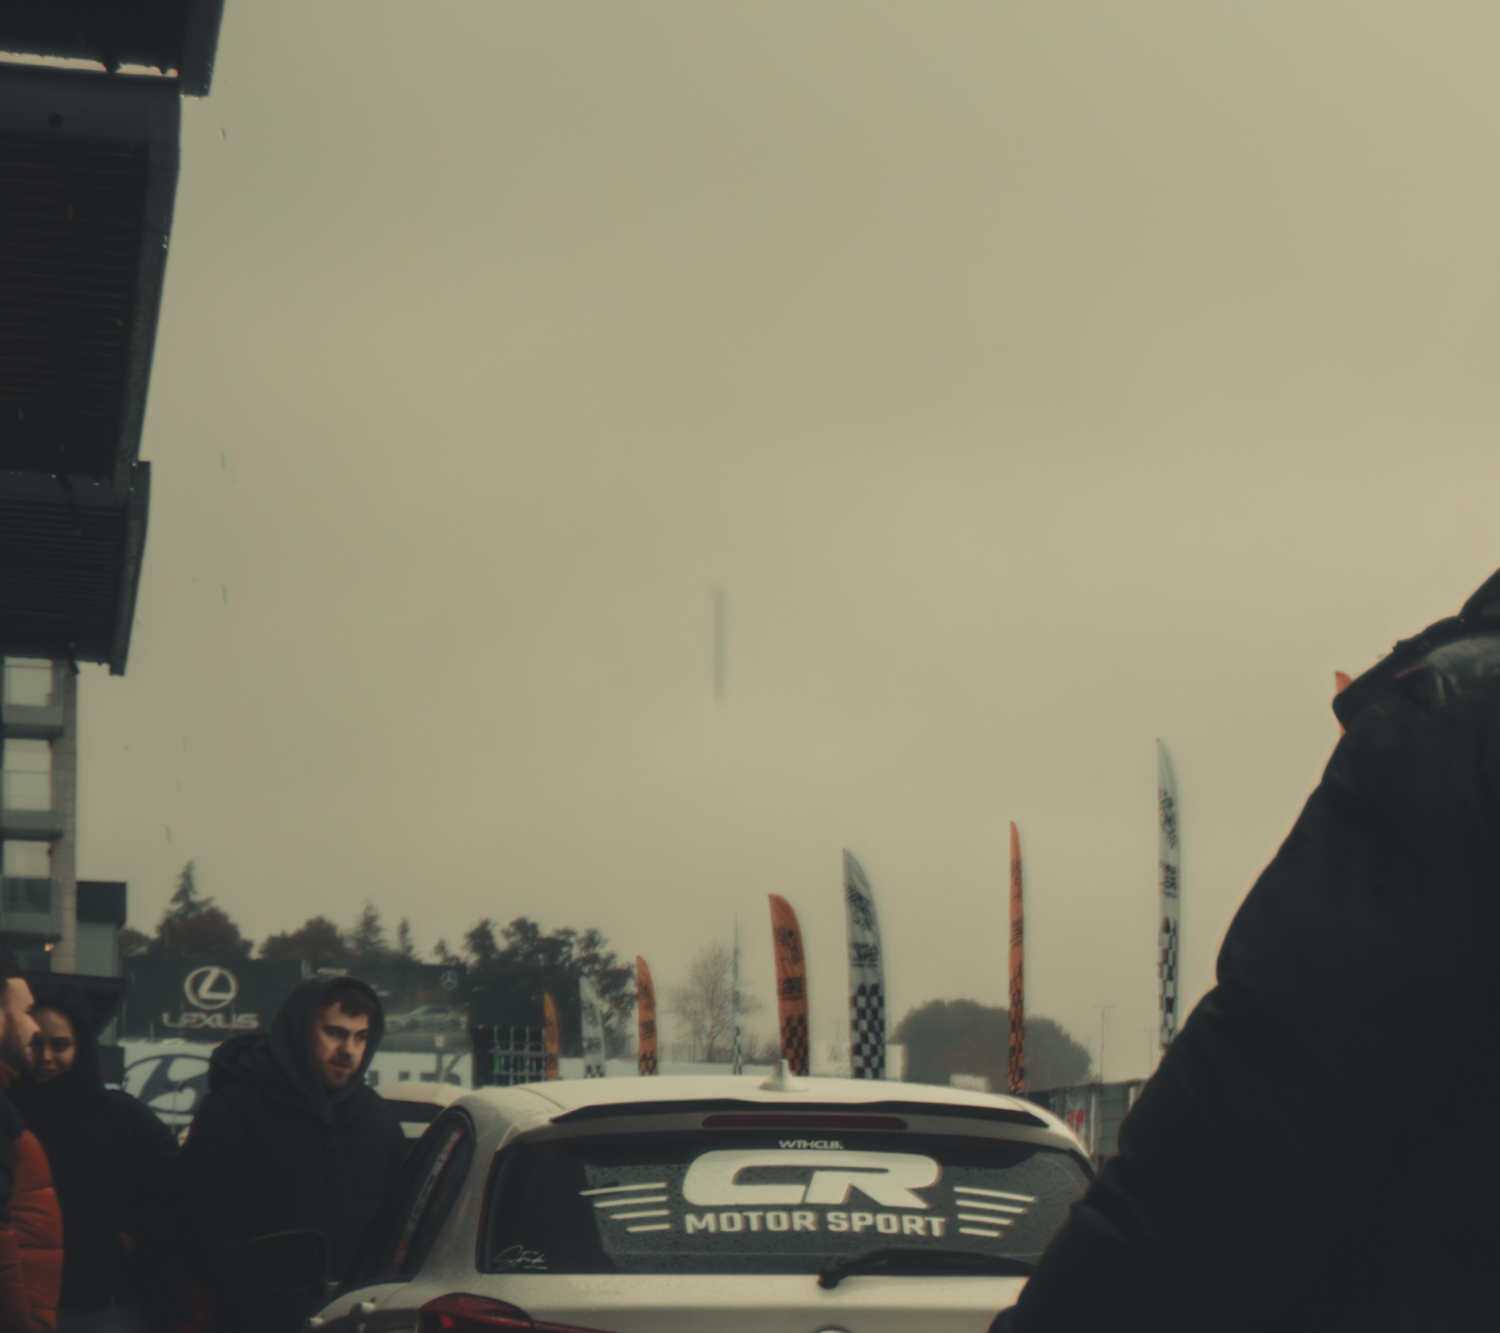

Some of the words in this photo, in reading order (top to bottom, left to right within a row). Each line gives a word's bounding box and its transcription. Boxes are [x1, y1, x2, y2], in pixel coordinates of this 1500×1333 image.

[162, 1012, 260, 1029] LEXUS
[684, 1211, 814, 1234] MOTOR
[827, 1212, 947, 1237] SPORT
